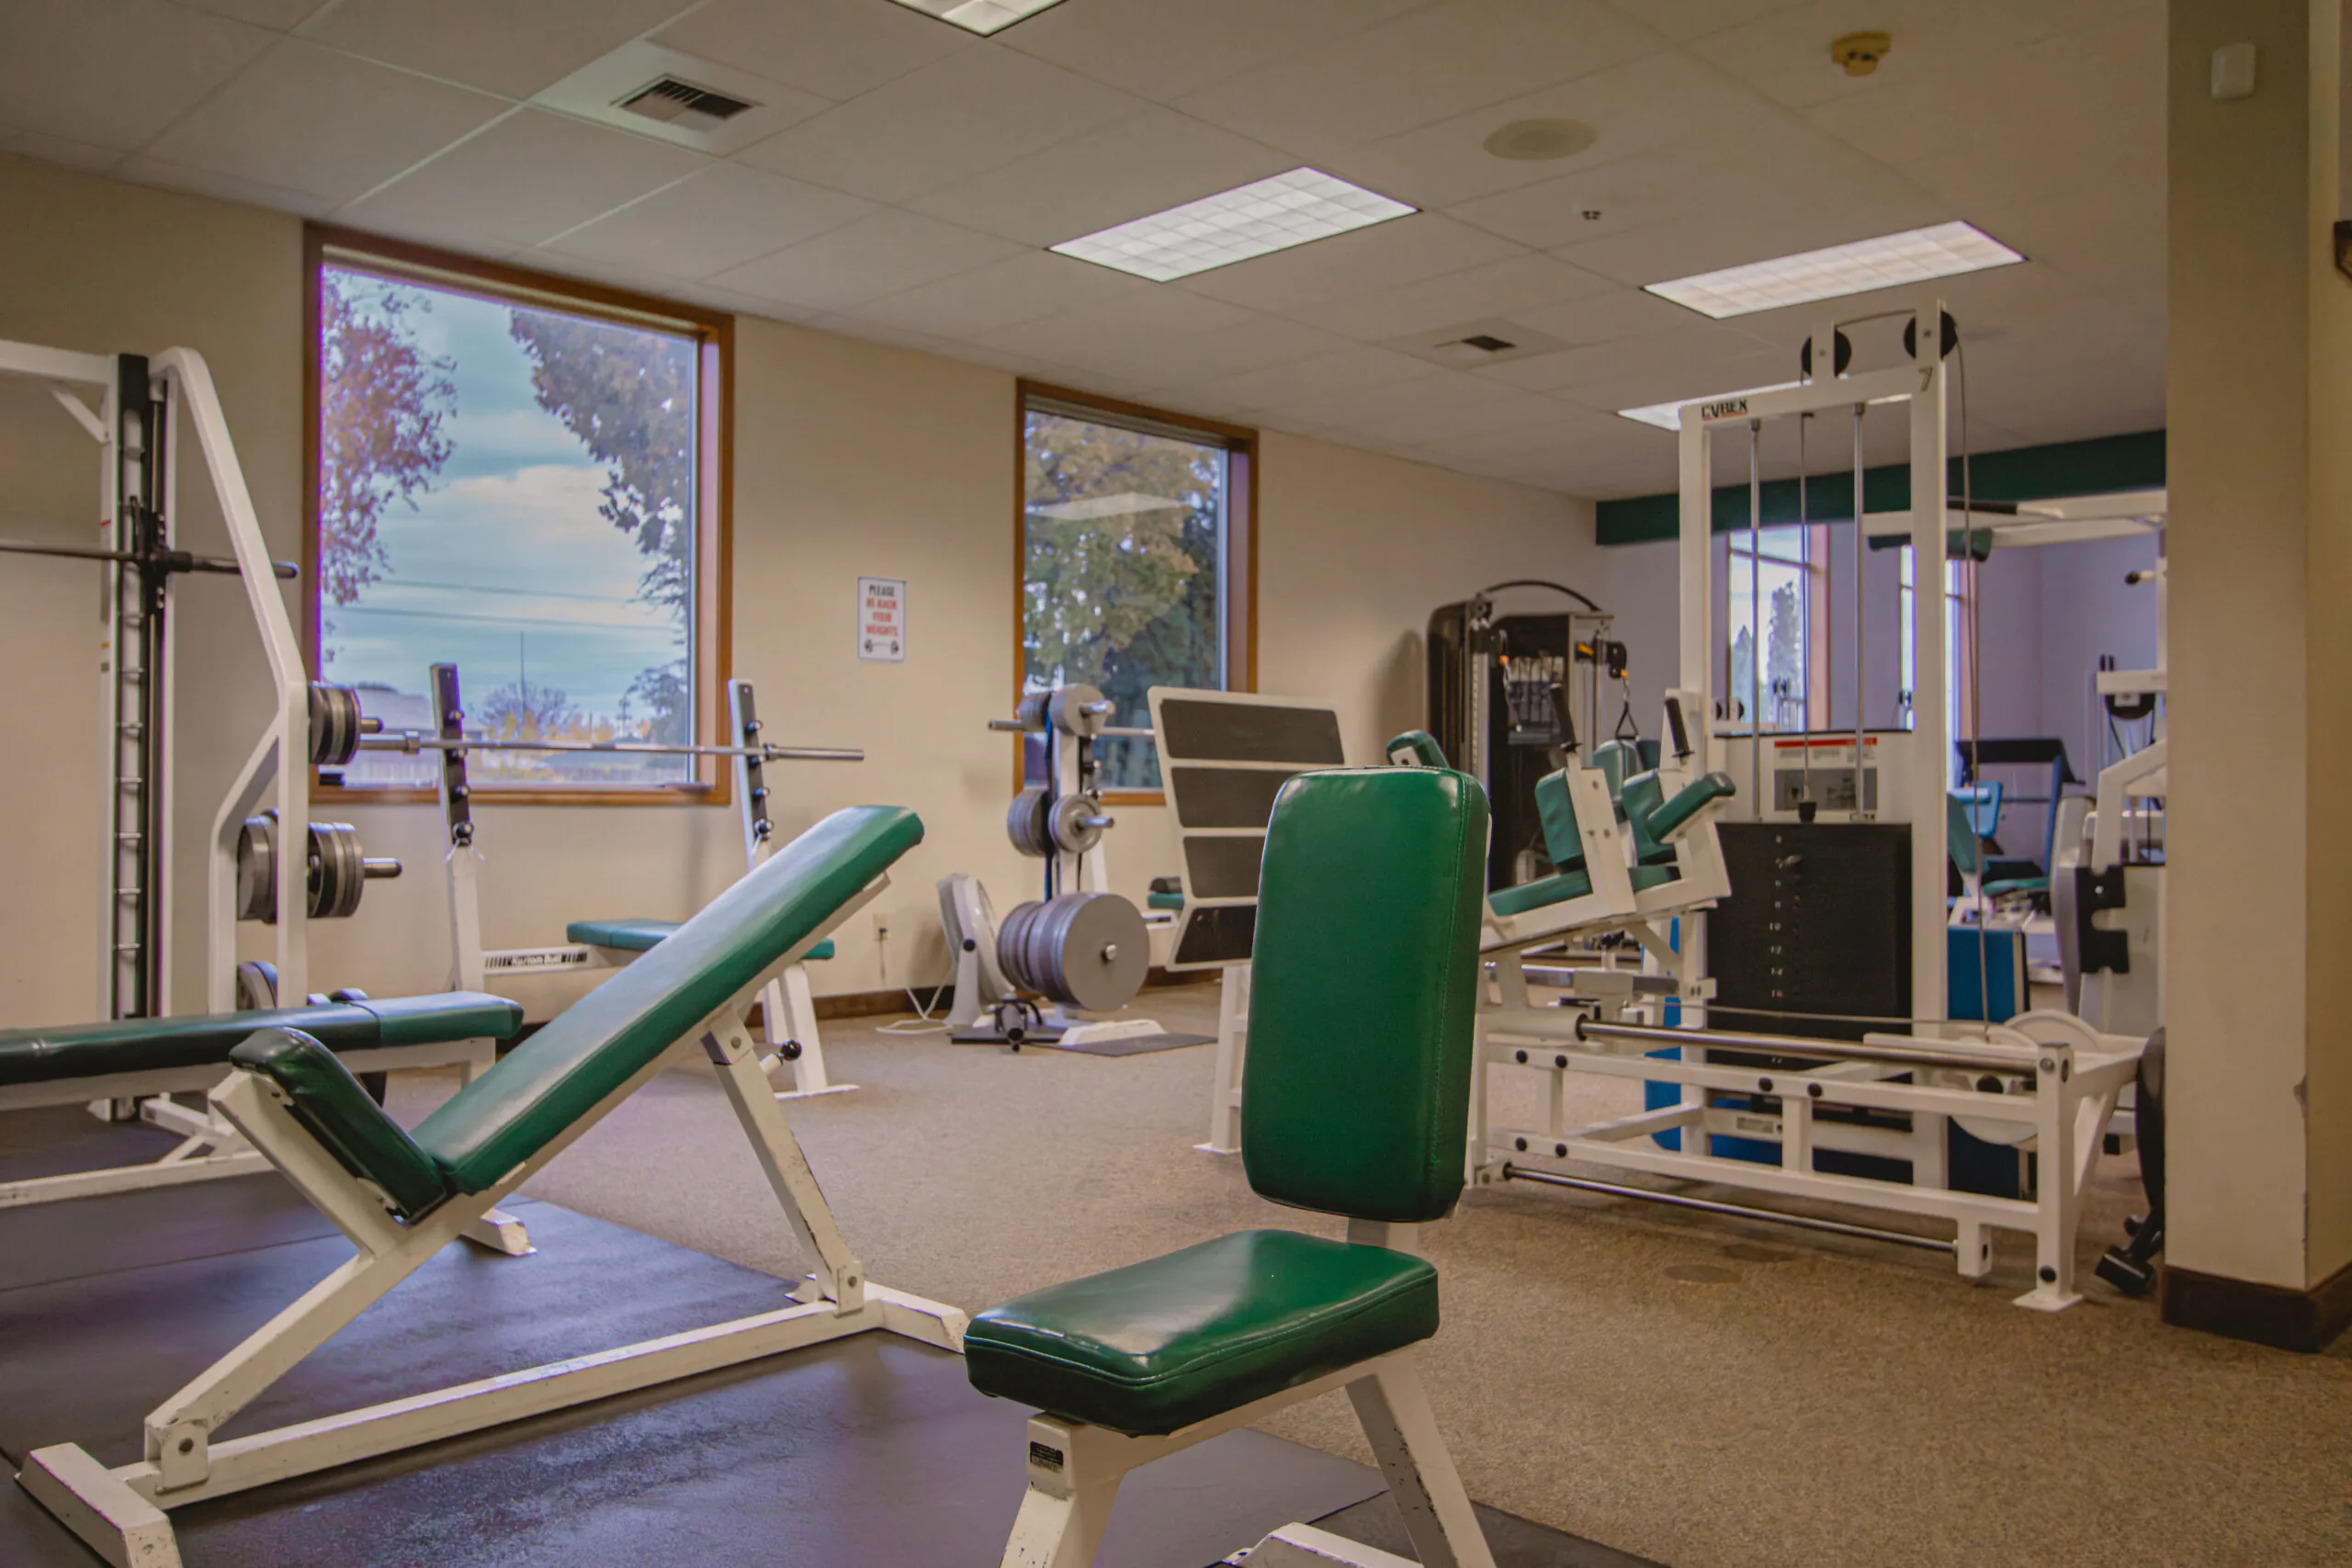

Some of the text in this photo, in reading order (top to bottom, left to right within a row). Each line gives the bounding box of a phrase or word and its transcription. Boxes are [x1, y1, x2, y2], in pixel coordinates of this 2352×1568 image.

[1918, 367, 1933, 392] 7
[1702, 399, 1747, 418] CYBEX
[869, 584, 895, 596] PLEASE
